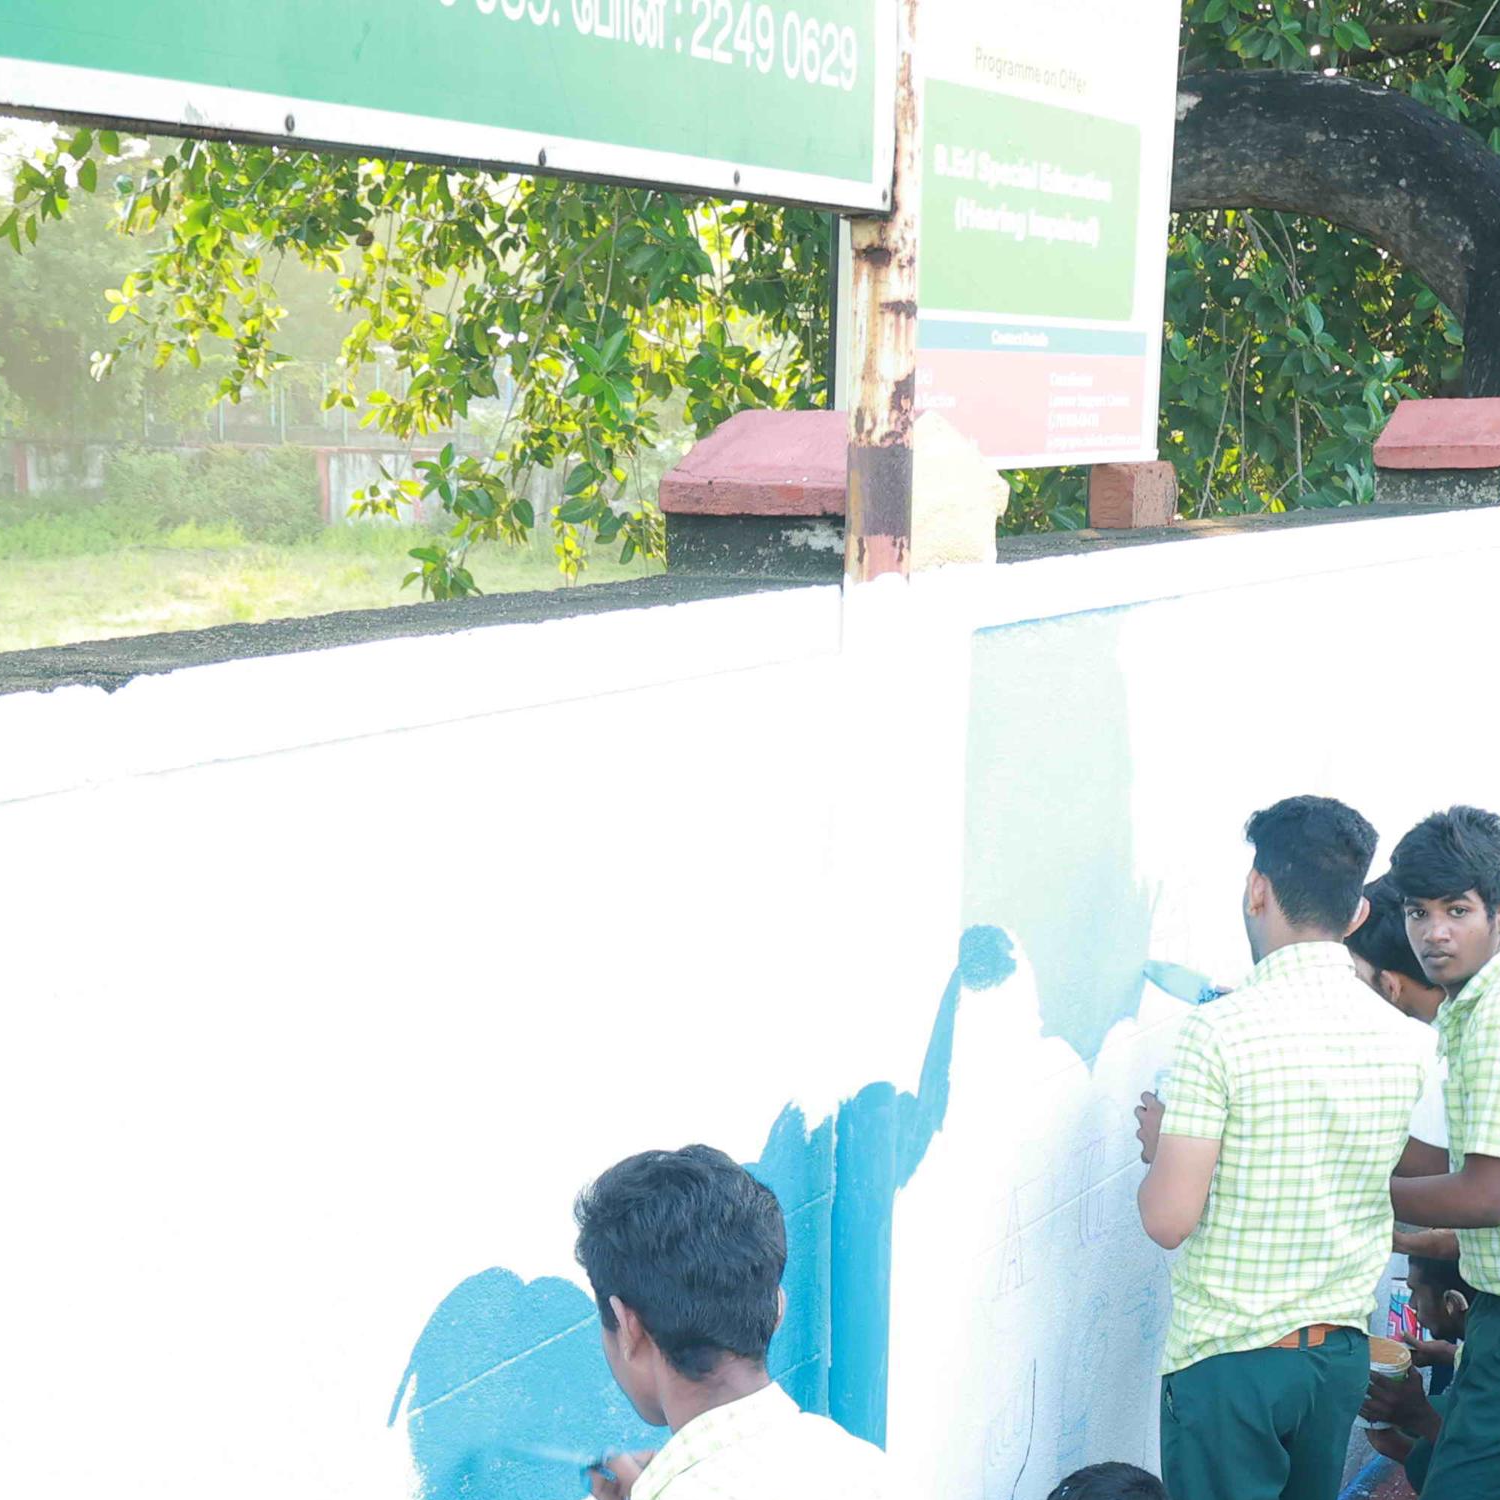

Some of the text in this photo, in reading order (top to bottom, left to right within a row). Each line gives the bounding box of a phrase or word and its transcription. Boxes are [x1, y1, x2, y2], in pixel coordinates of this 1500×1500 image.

[691, 0, 773, 74] 2249
[782, 11, 858, 91] 0629
[973, 46, 1088, 95] Programme on Offer
